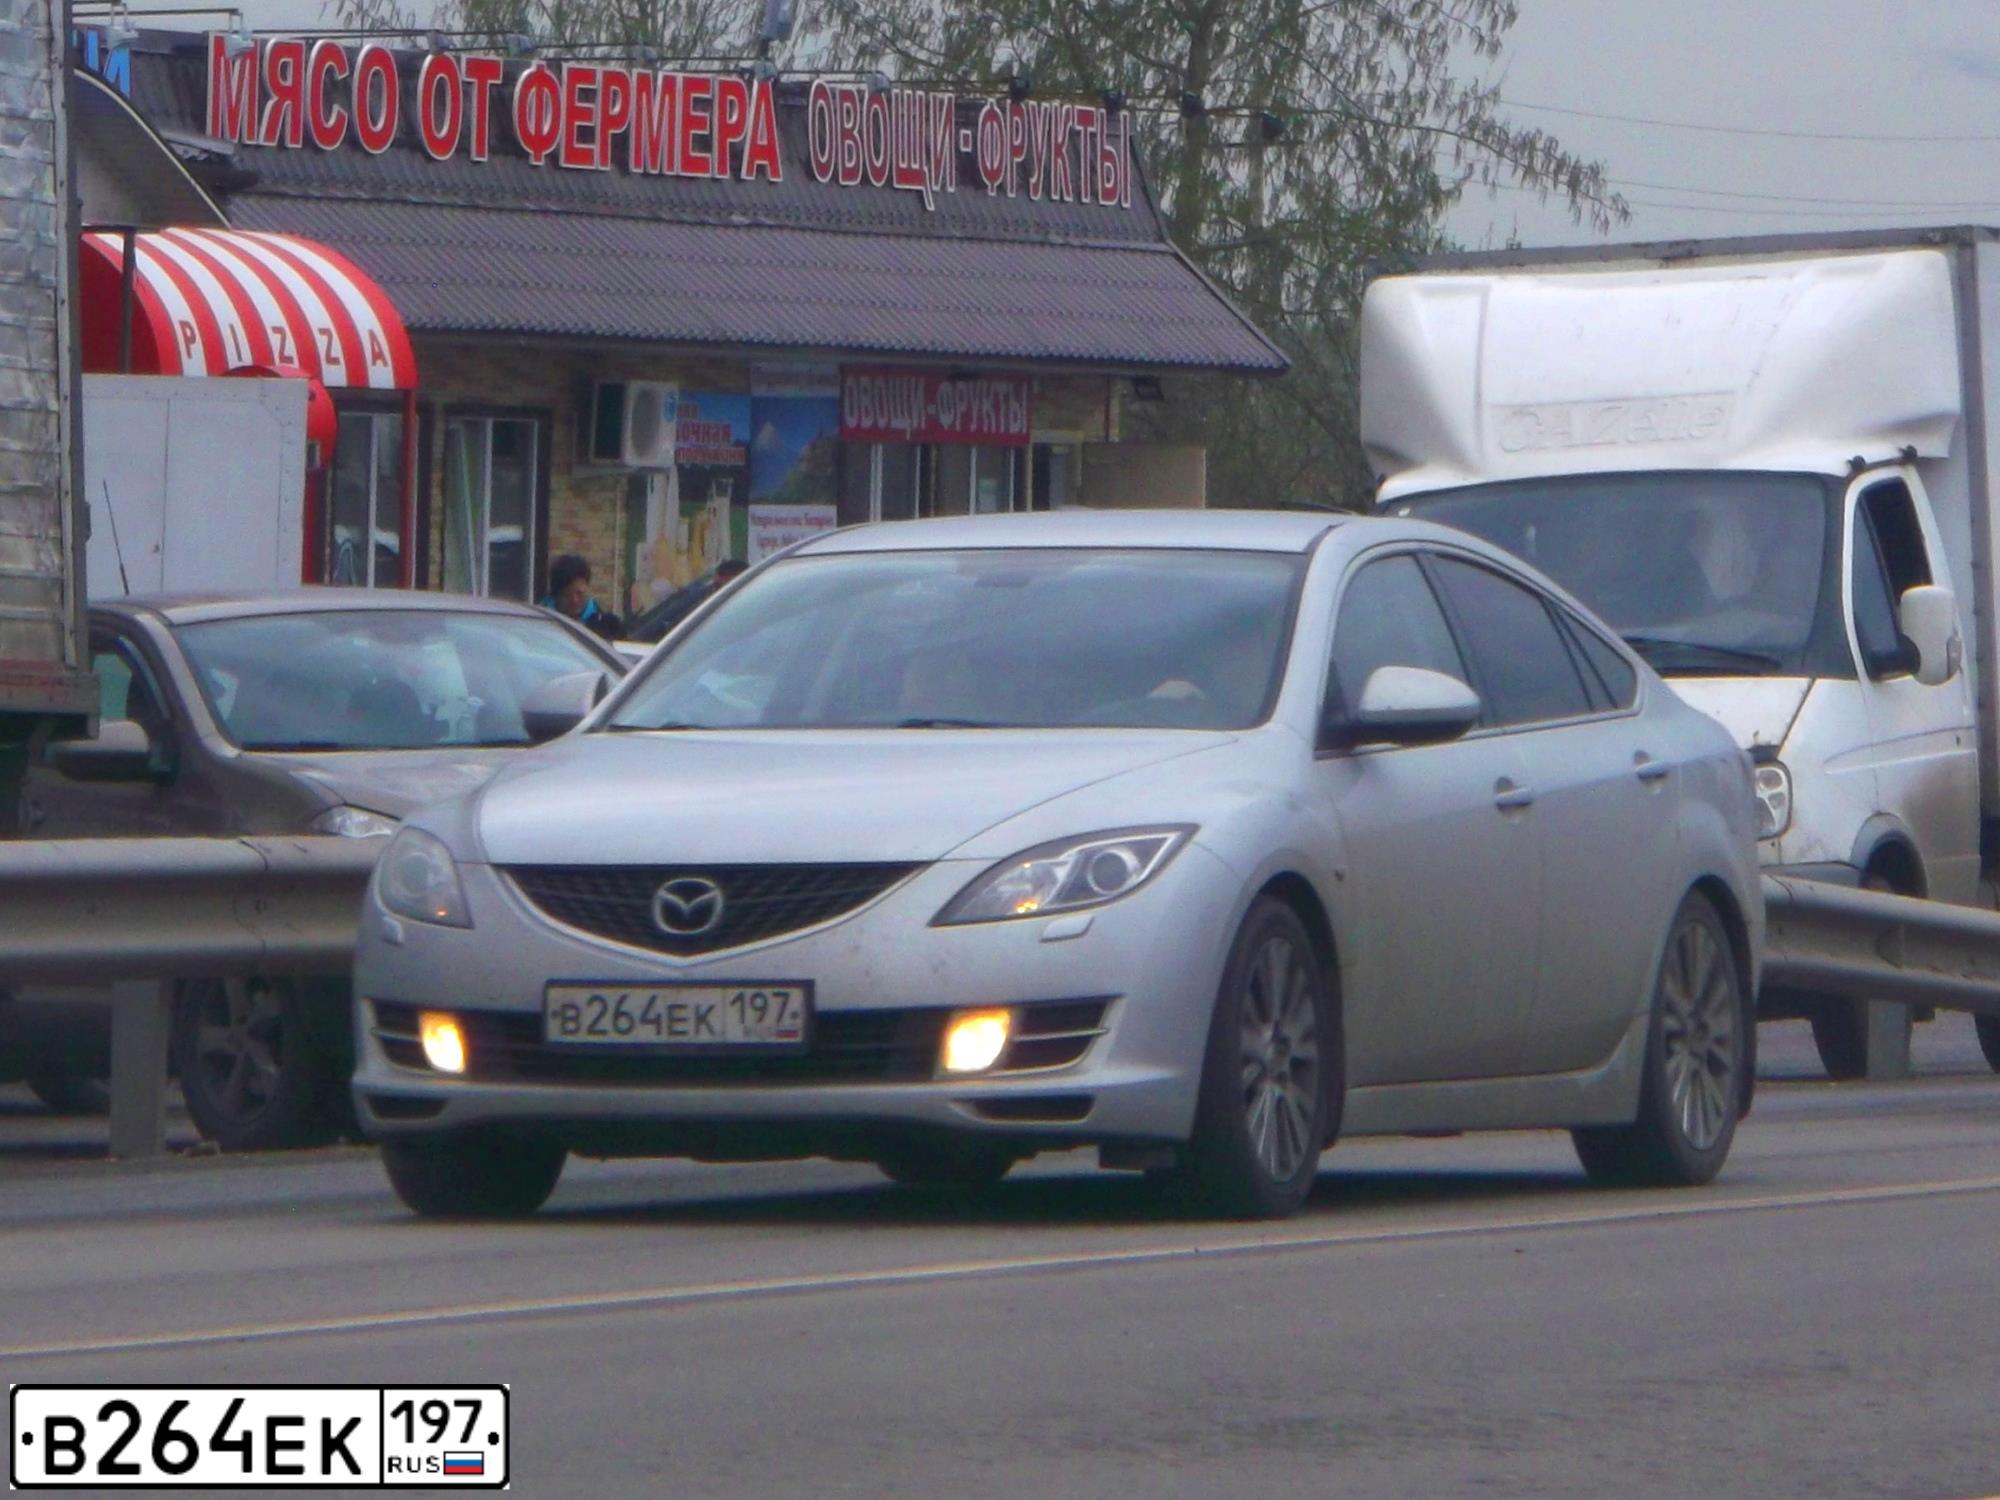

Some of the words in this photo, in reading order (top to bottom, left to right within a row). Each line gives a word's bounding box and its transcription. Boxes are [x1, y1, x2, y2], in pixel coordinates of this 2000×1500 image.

[207, 33, 398, 153] МЯСО
[418, 53, 501, 162] ОТ
[513, 61, 783, 182] ФЕРМЕРА
[808, 79, 1131, 210] ОВОЩИ-ФРУКТЫ
[179, 320, 389, 368] PIZZA
[842, 375, 1028, 439] ОВОЩИ-ФРУКТЫ
[559, 993, 717, 1036] В264ЕК
[730, 992, 791, 1025] 197
